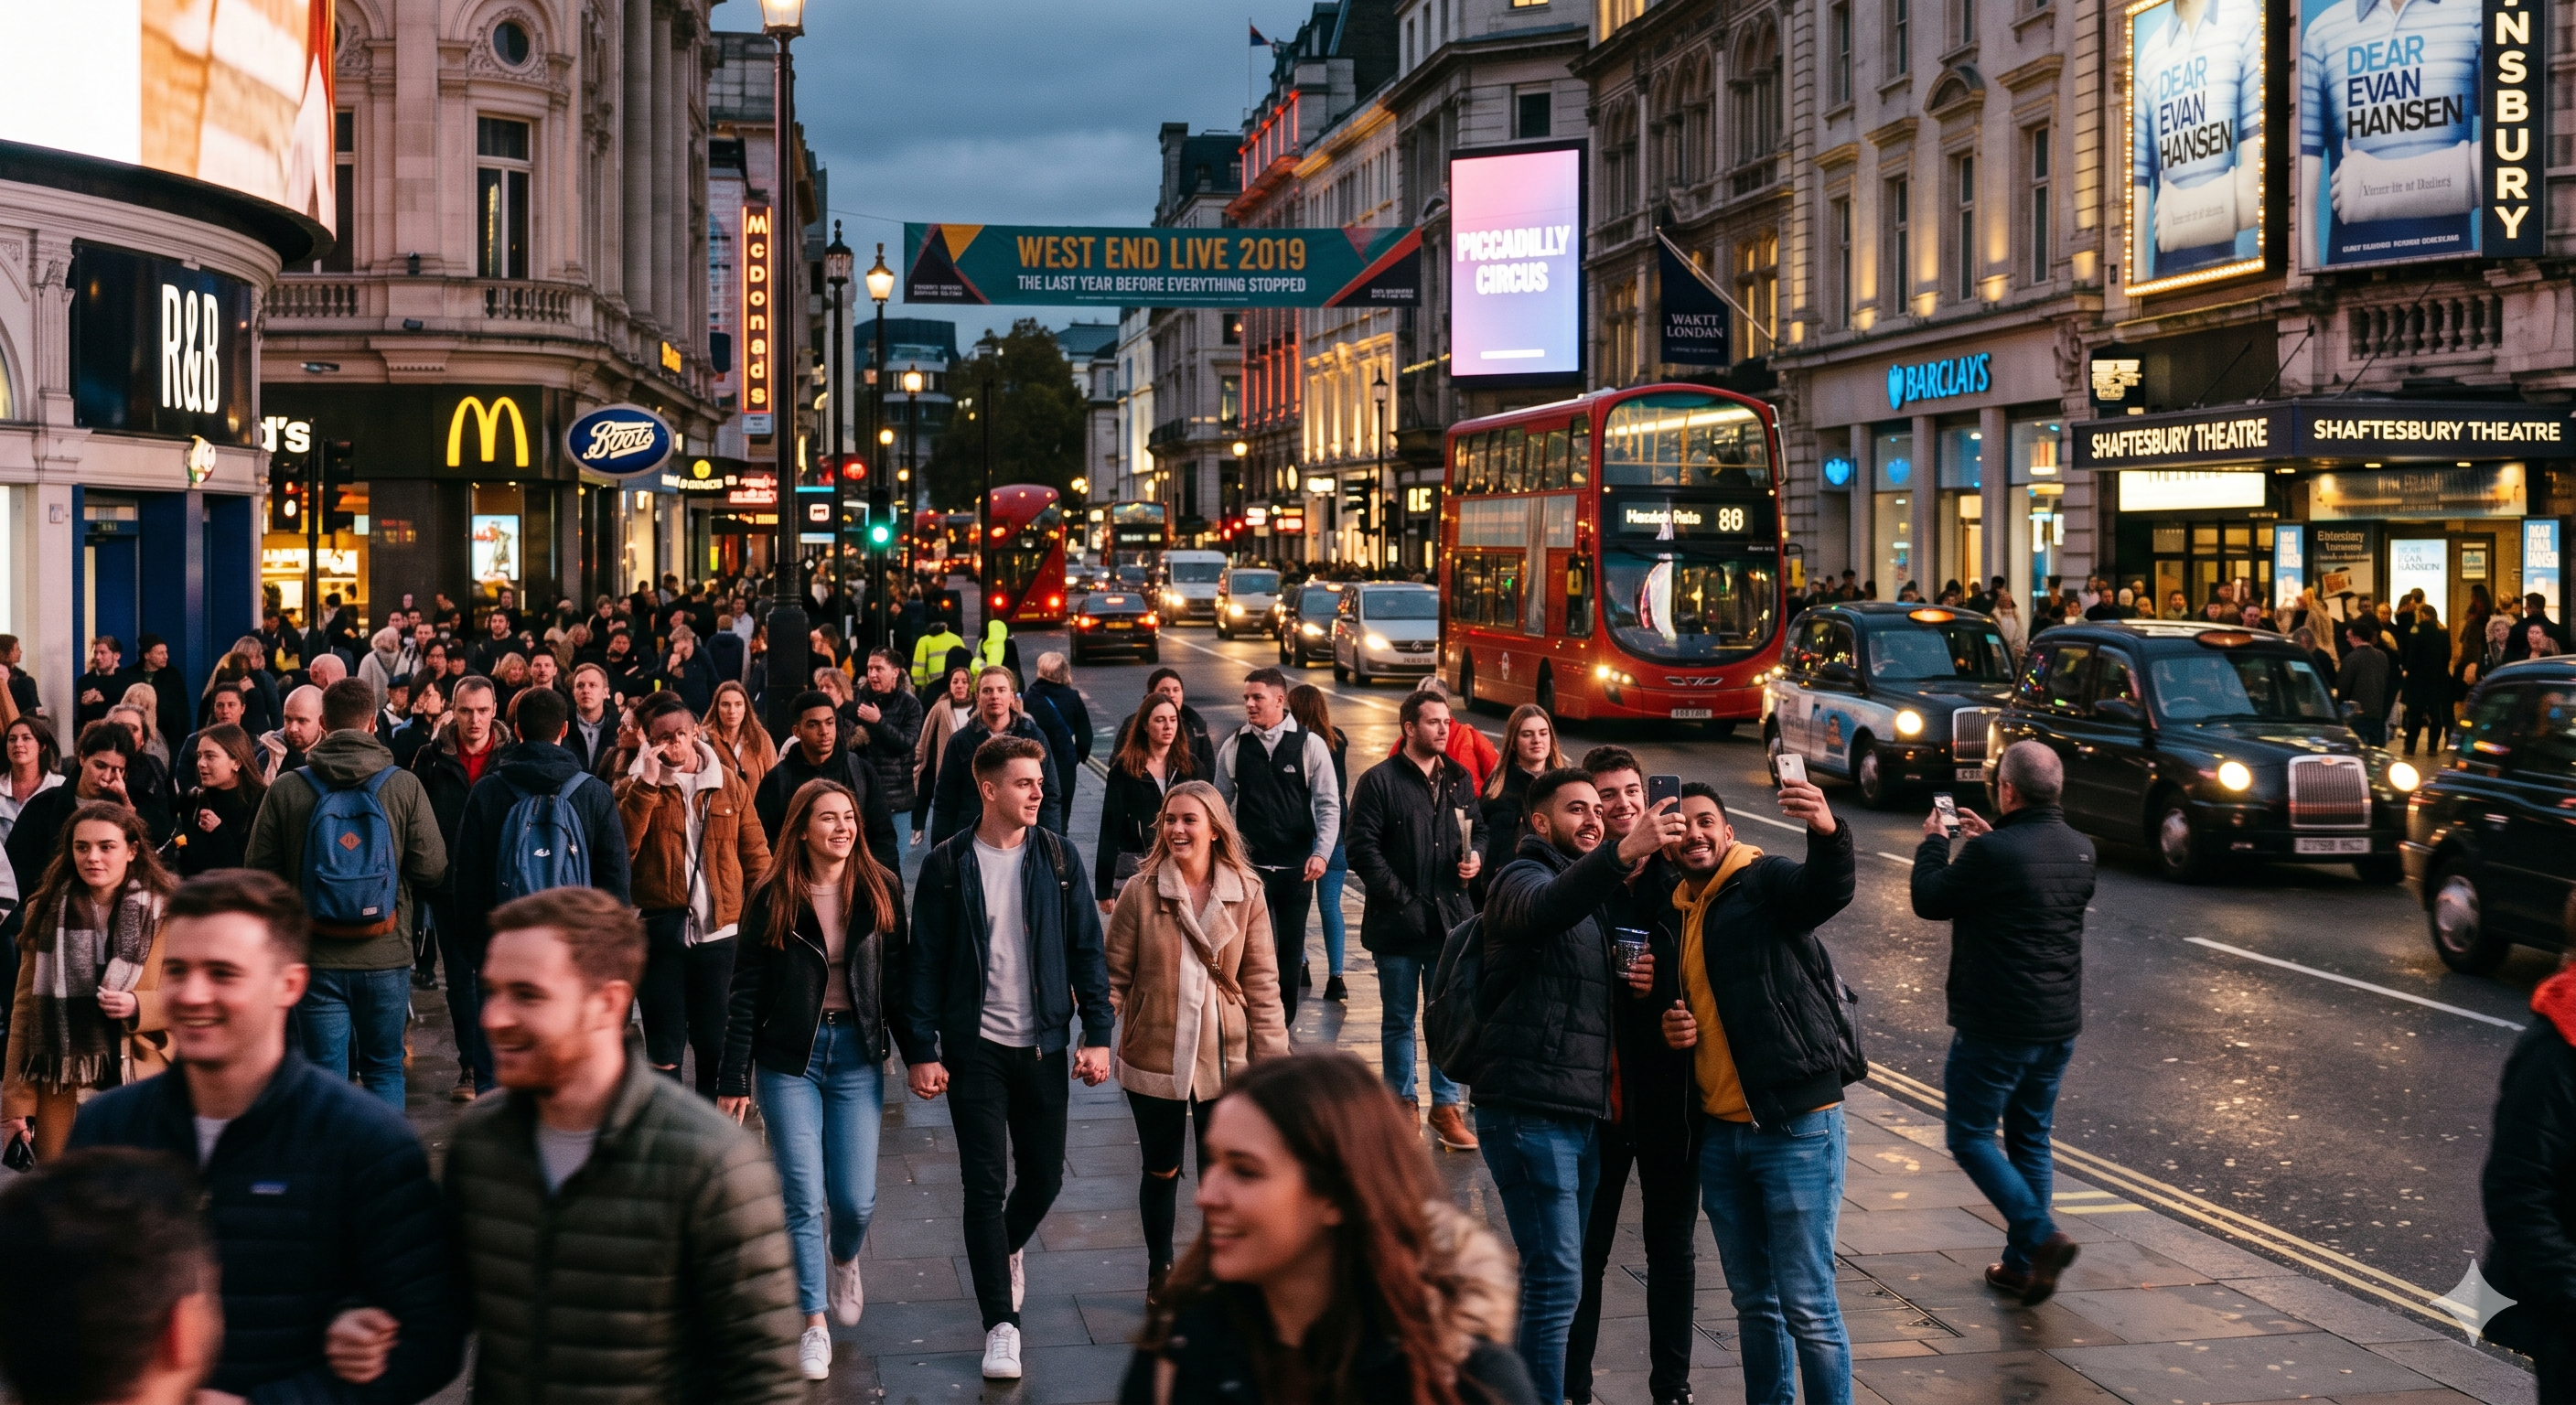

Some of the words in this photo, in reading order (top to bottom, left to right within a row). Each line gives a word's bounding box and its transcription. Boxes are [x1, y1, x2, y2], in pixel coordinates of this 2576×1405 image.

[2347, 35, 2424, 76] DEAR
[2159, 55, 2207, 101] DEAR
[2347, 68, 2420, 107] EVAN
[2159, 91, 2206, 135] EVAN
[2346, 94, 2463, 140] HANSEN
[2494, 0, 2530, 240] NSBURY
[2159, 119, 2233, 170] HANSEN
[1017, 236, 1096, 268] WEST
[1105, 237, 1160, 269] END
[1170, 237, 1228, 270] LIVE
[1240, 238, 1305, 271] 2019
[1456, 225, 1571, 263] PICCADILLY
[1017, 275, 1042, 291] THE
[1045, 275, 1076, 291] LAST
[1079, 275, 1113, 292] YEAR
[1116, 276, 1164, 292] BEFORE
[1168, 276, 1245, 292] EVERYTHING
[1249, 277, 1305, 293] STOPPED
[1476, 262, 1549, 295] CIRCUS
[162, 284, 220, 413] R&B
[1905, 352, 1991, 402] BARCLAYS
[583, 421, 656, 460] Boots
[2092, 424, 2191, 460] SHAFTESBURY
[2195, 417, 2268, 452] THEATRE
[2313, 420, 2463, 441] SHAFTESBURY
[2468, 421, 2561, 442] THEATRE
